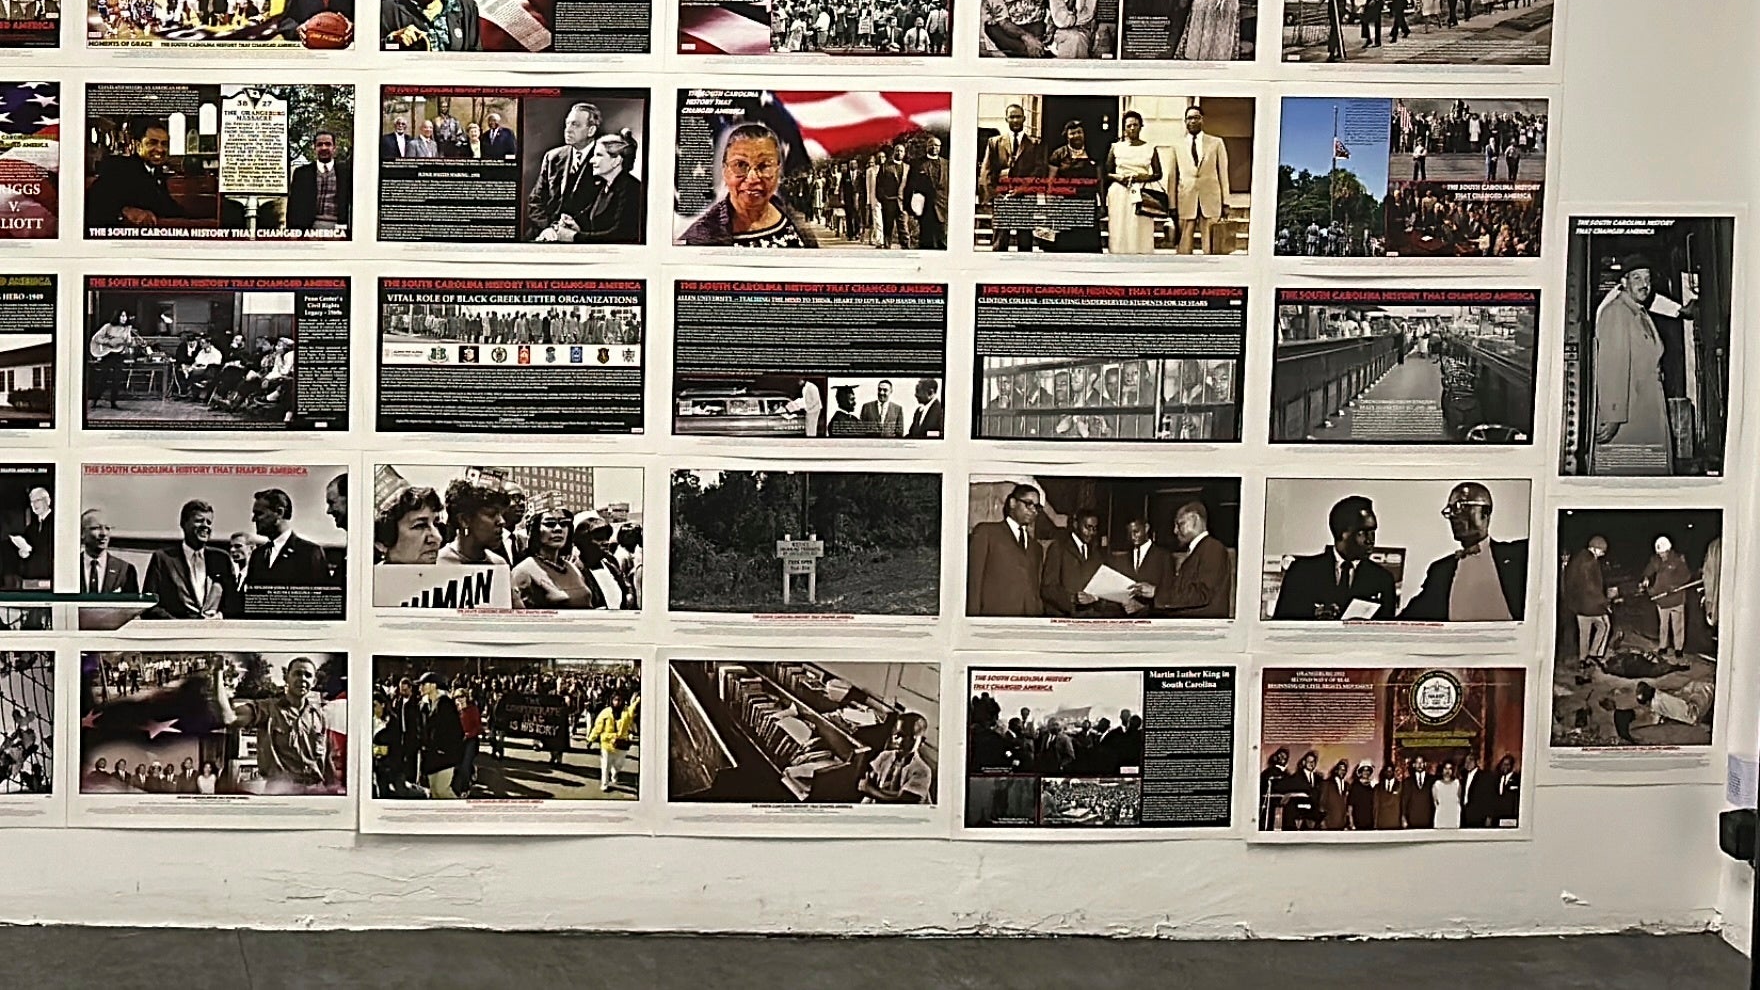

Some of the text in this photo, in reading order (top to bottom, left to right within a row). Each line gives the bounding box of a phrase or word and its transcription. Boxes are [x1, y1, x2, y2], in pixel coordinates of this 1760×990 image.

[8, 201, 20, 212] V.
[89, 227, 106, 236] THE
[107, 227, 139, 236] SOUTH
[140, 228, 189, 237] CAROLINA
[191, 228, 229, 238] HISTORY
[256, 228, 302, 238] CHANGED
[304, 228, 346, 238] AMERICA
[387, 294, 638, 304] VITAL ROLE OF BLACK GREEK LETTER ORGANIZATIONS
[400, 569, 494, 609] MAN
[1149, 670, 1230, 680] Martin Luther King in
[1161, 681, 1184, 689] South
